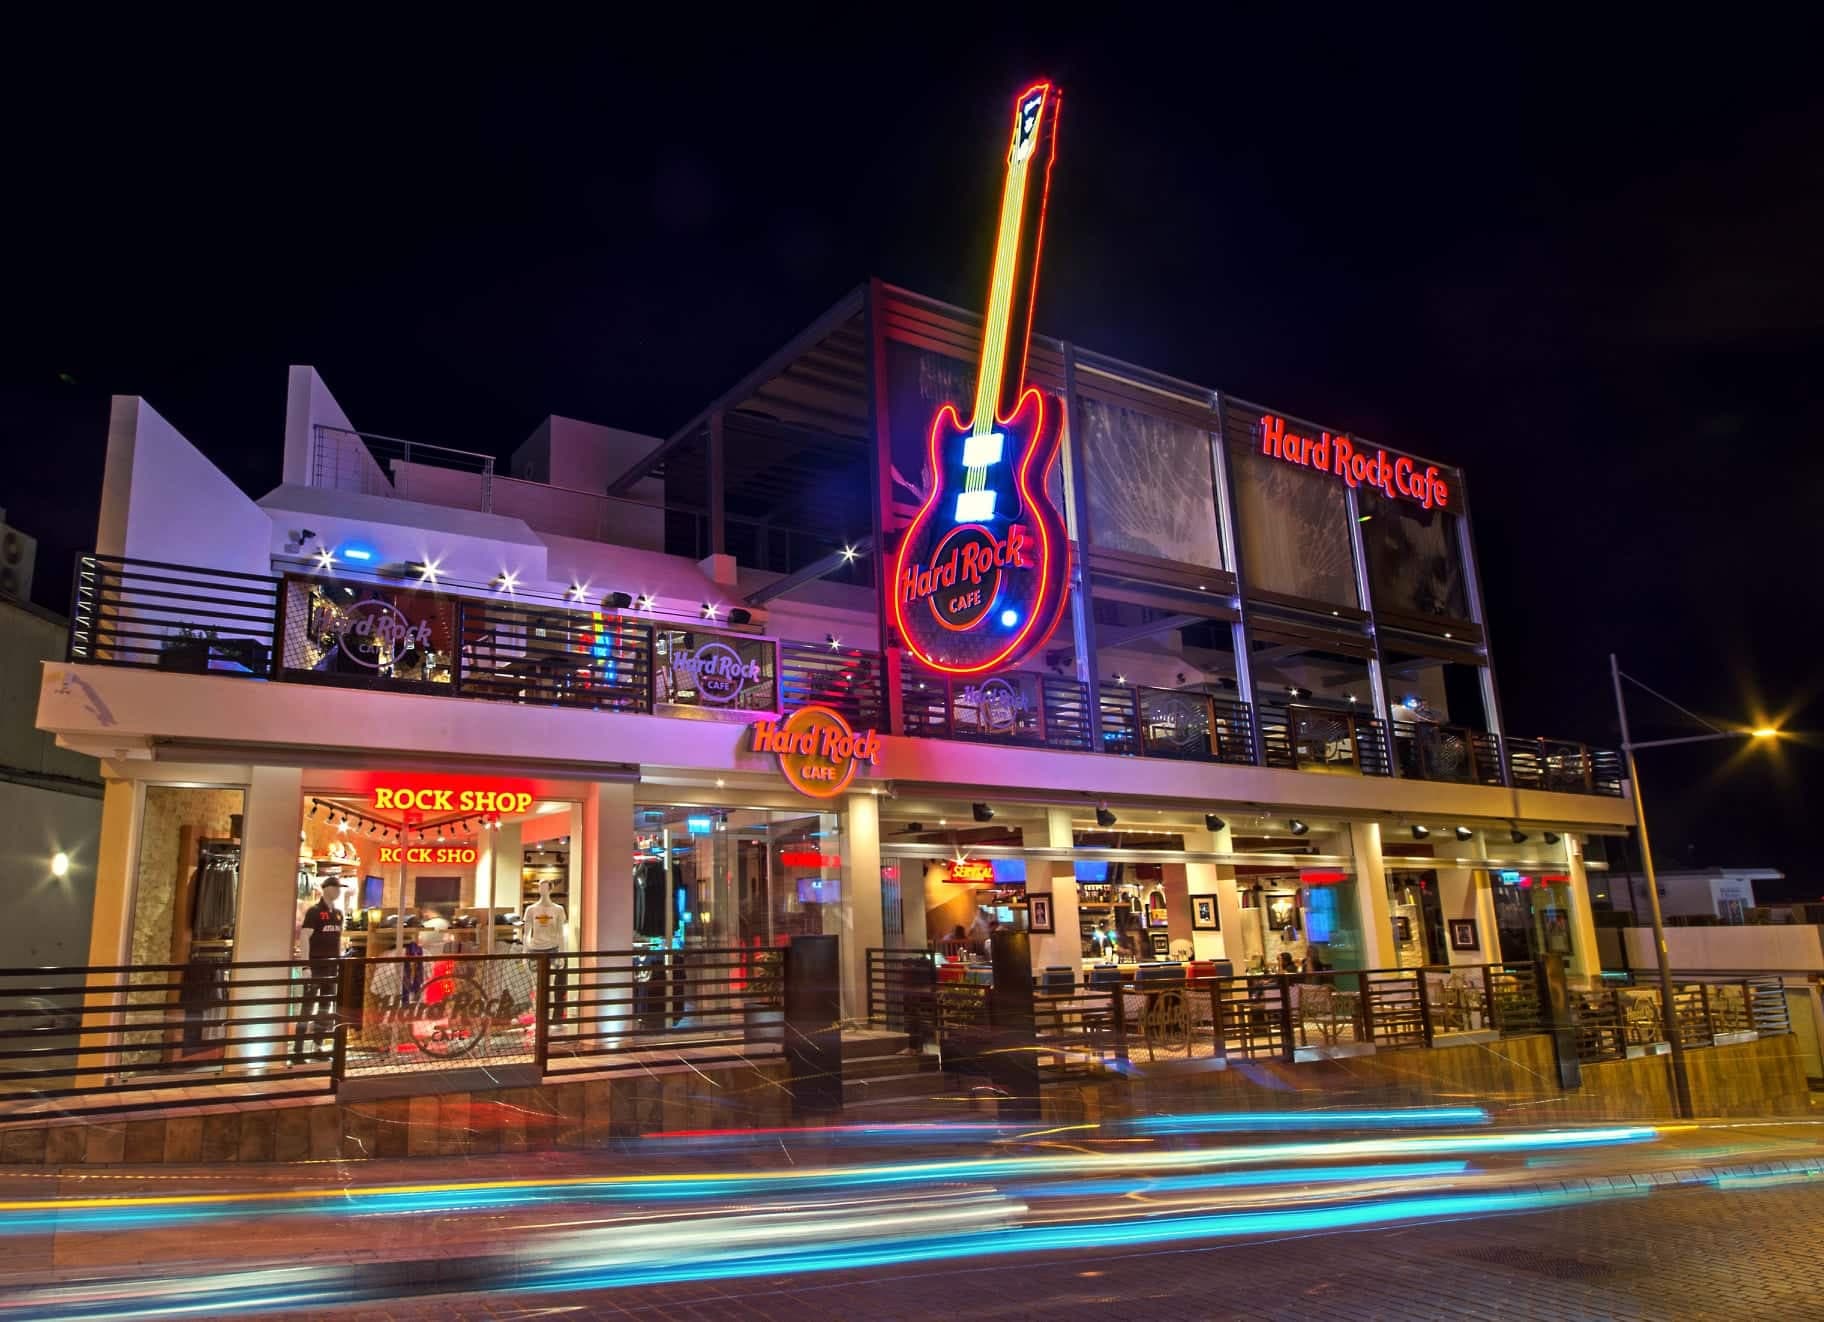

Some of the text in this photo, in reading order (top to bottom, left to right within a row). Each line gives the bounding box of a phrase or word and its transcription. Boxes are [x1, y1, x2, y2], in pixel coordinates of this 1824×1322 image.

[1261, 414, 1449, 510] Hard Rock Cafe
[901, 523, 1024, 603] Hard Rock
[949, 589, 982, 613] CAFE
[311, 607, 432, 647] Hard Rock
[673, 651, 760, 683] Hard Rock
[707, 679, 731, 691] CAFE
[754, 719, 881, 765] Hard Rock
[801, 765, 836, 780] CAFE
[374, 787, 533, 813] ROCK SHOP
[380, 847, 433, 863] ROCK
